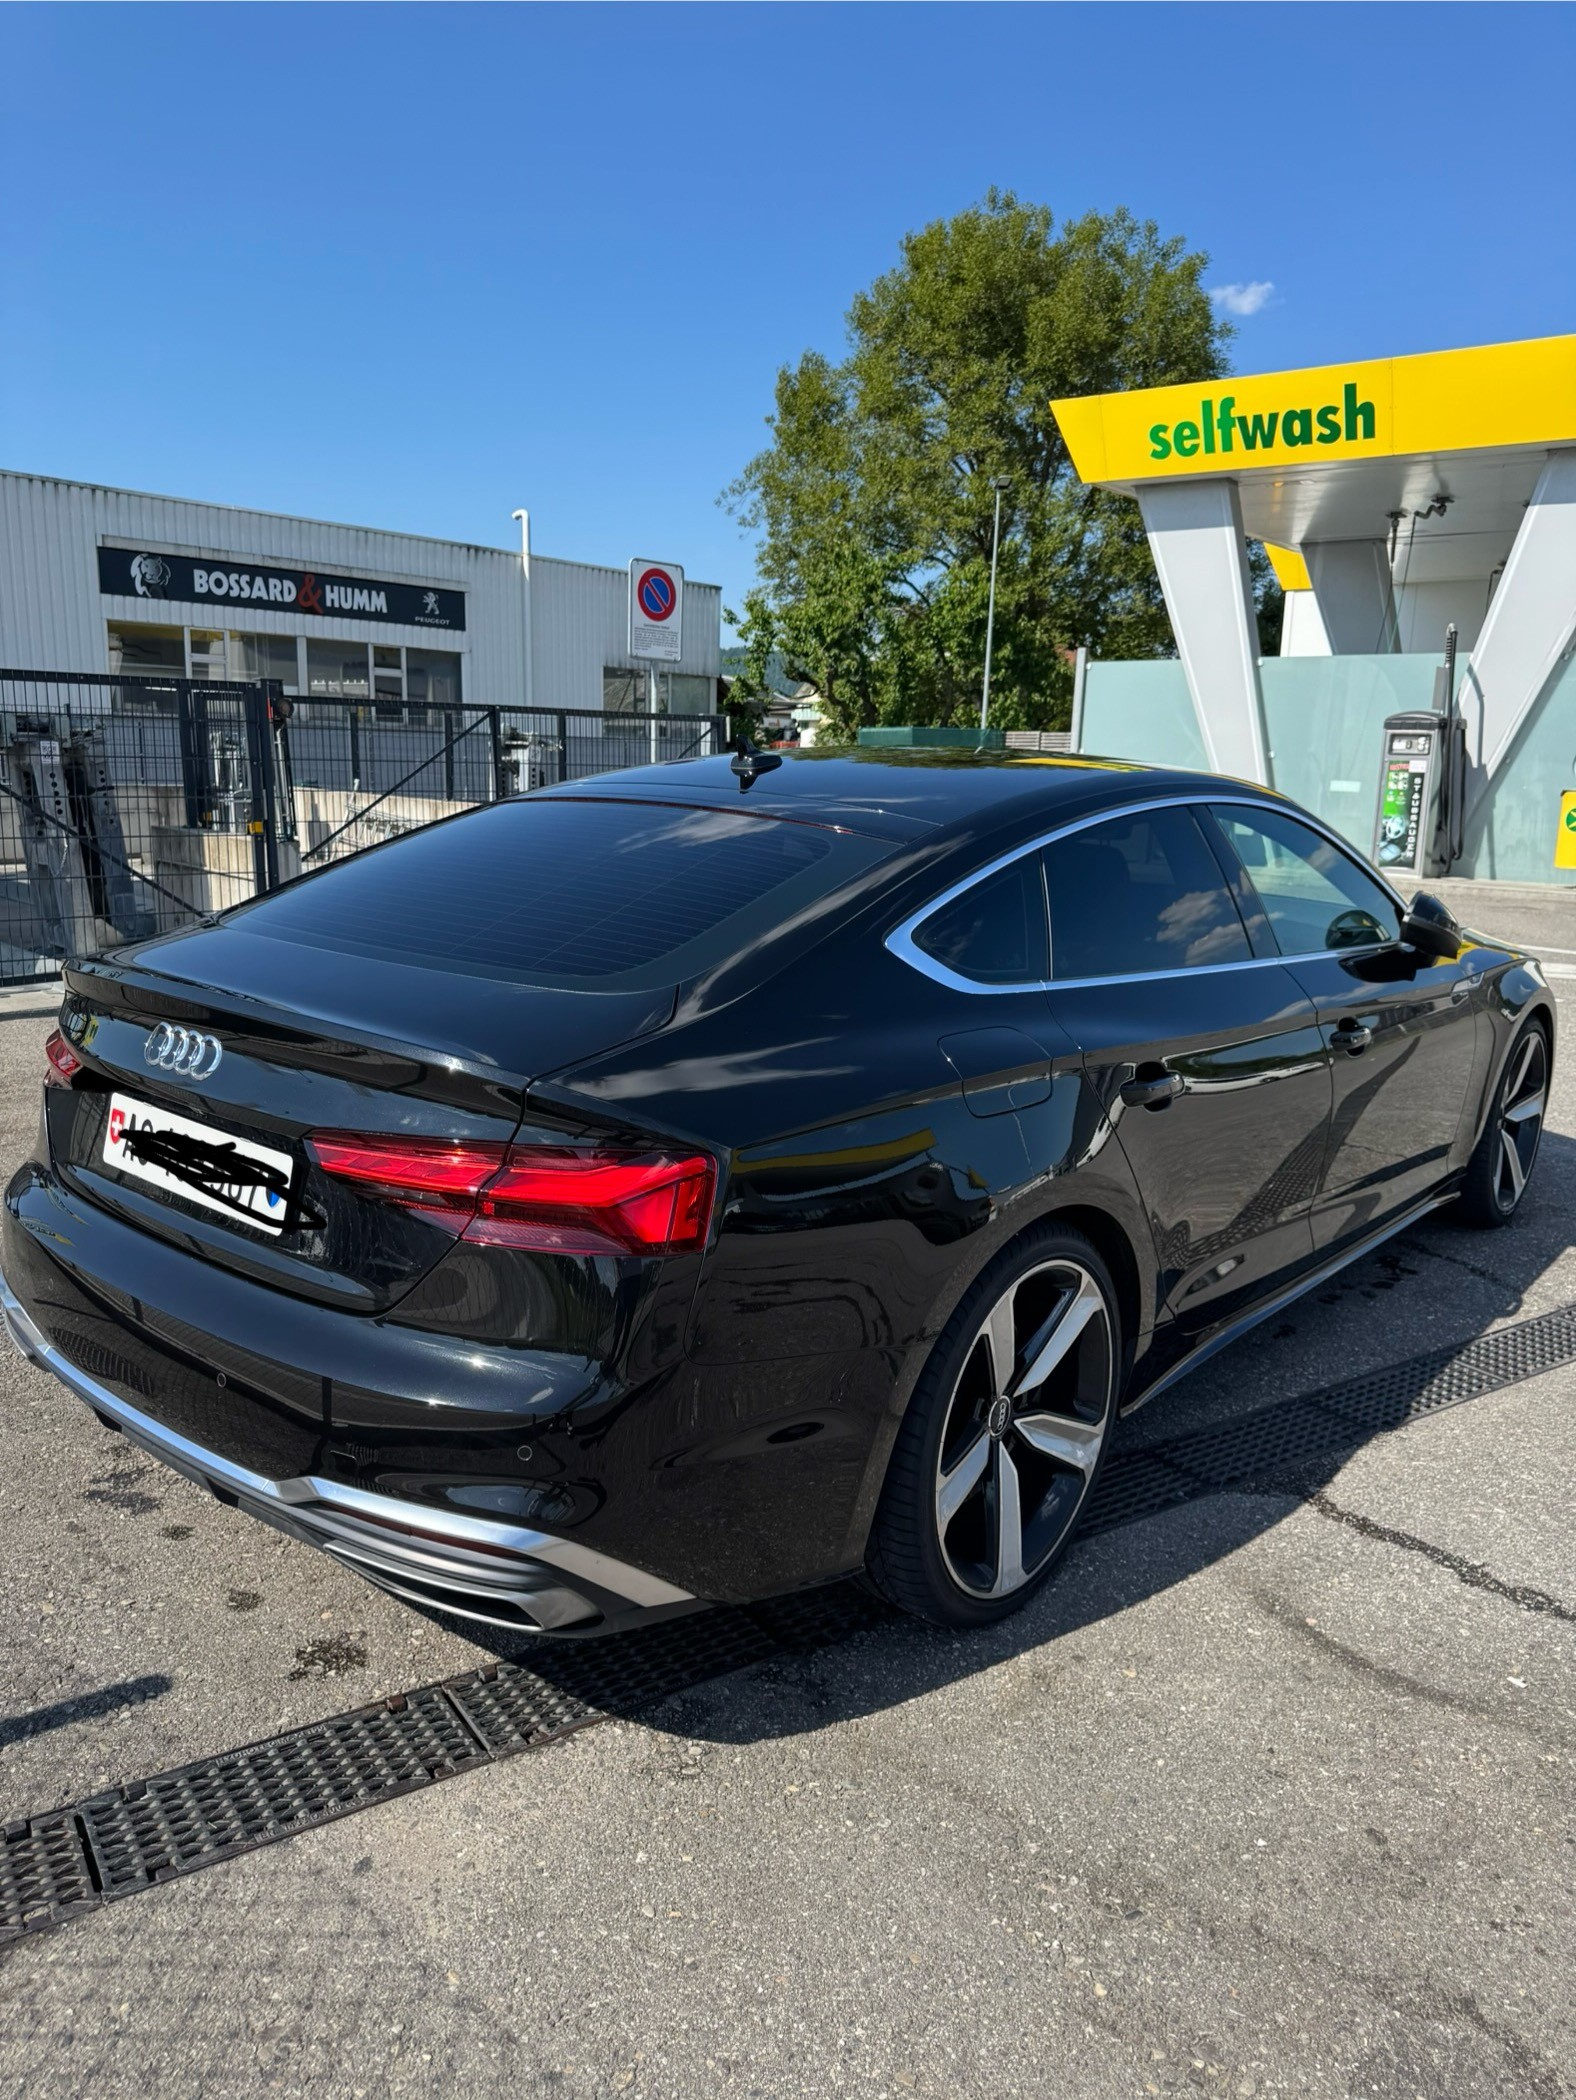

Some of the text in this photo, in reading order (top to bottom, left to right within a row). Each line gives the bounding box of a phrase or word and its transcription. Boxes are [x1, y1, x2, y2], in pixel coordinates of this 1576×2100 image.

[1149, 383, 1376, 460] selfwash
[193, 569, 388, 615] BOSSARD & HUMM
[414, 616, 450, 625] PEUGEOT
